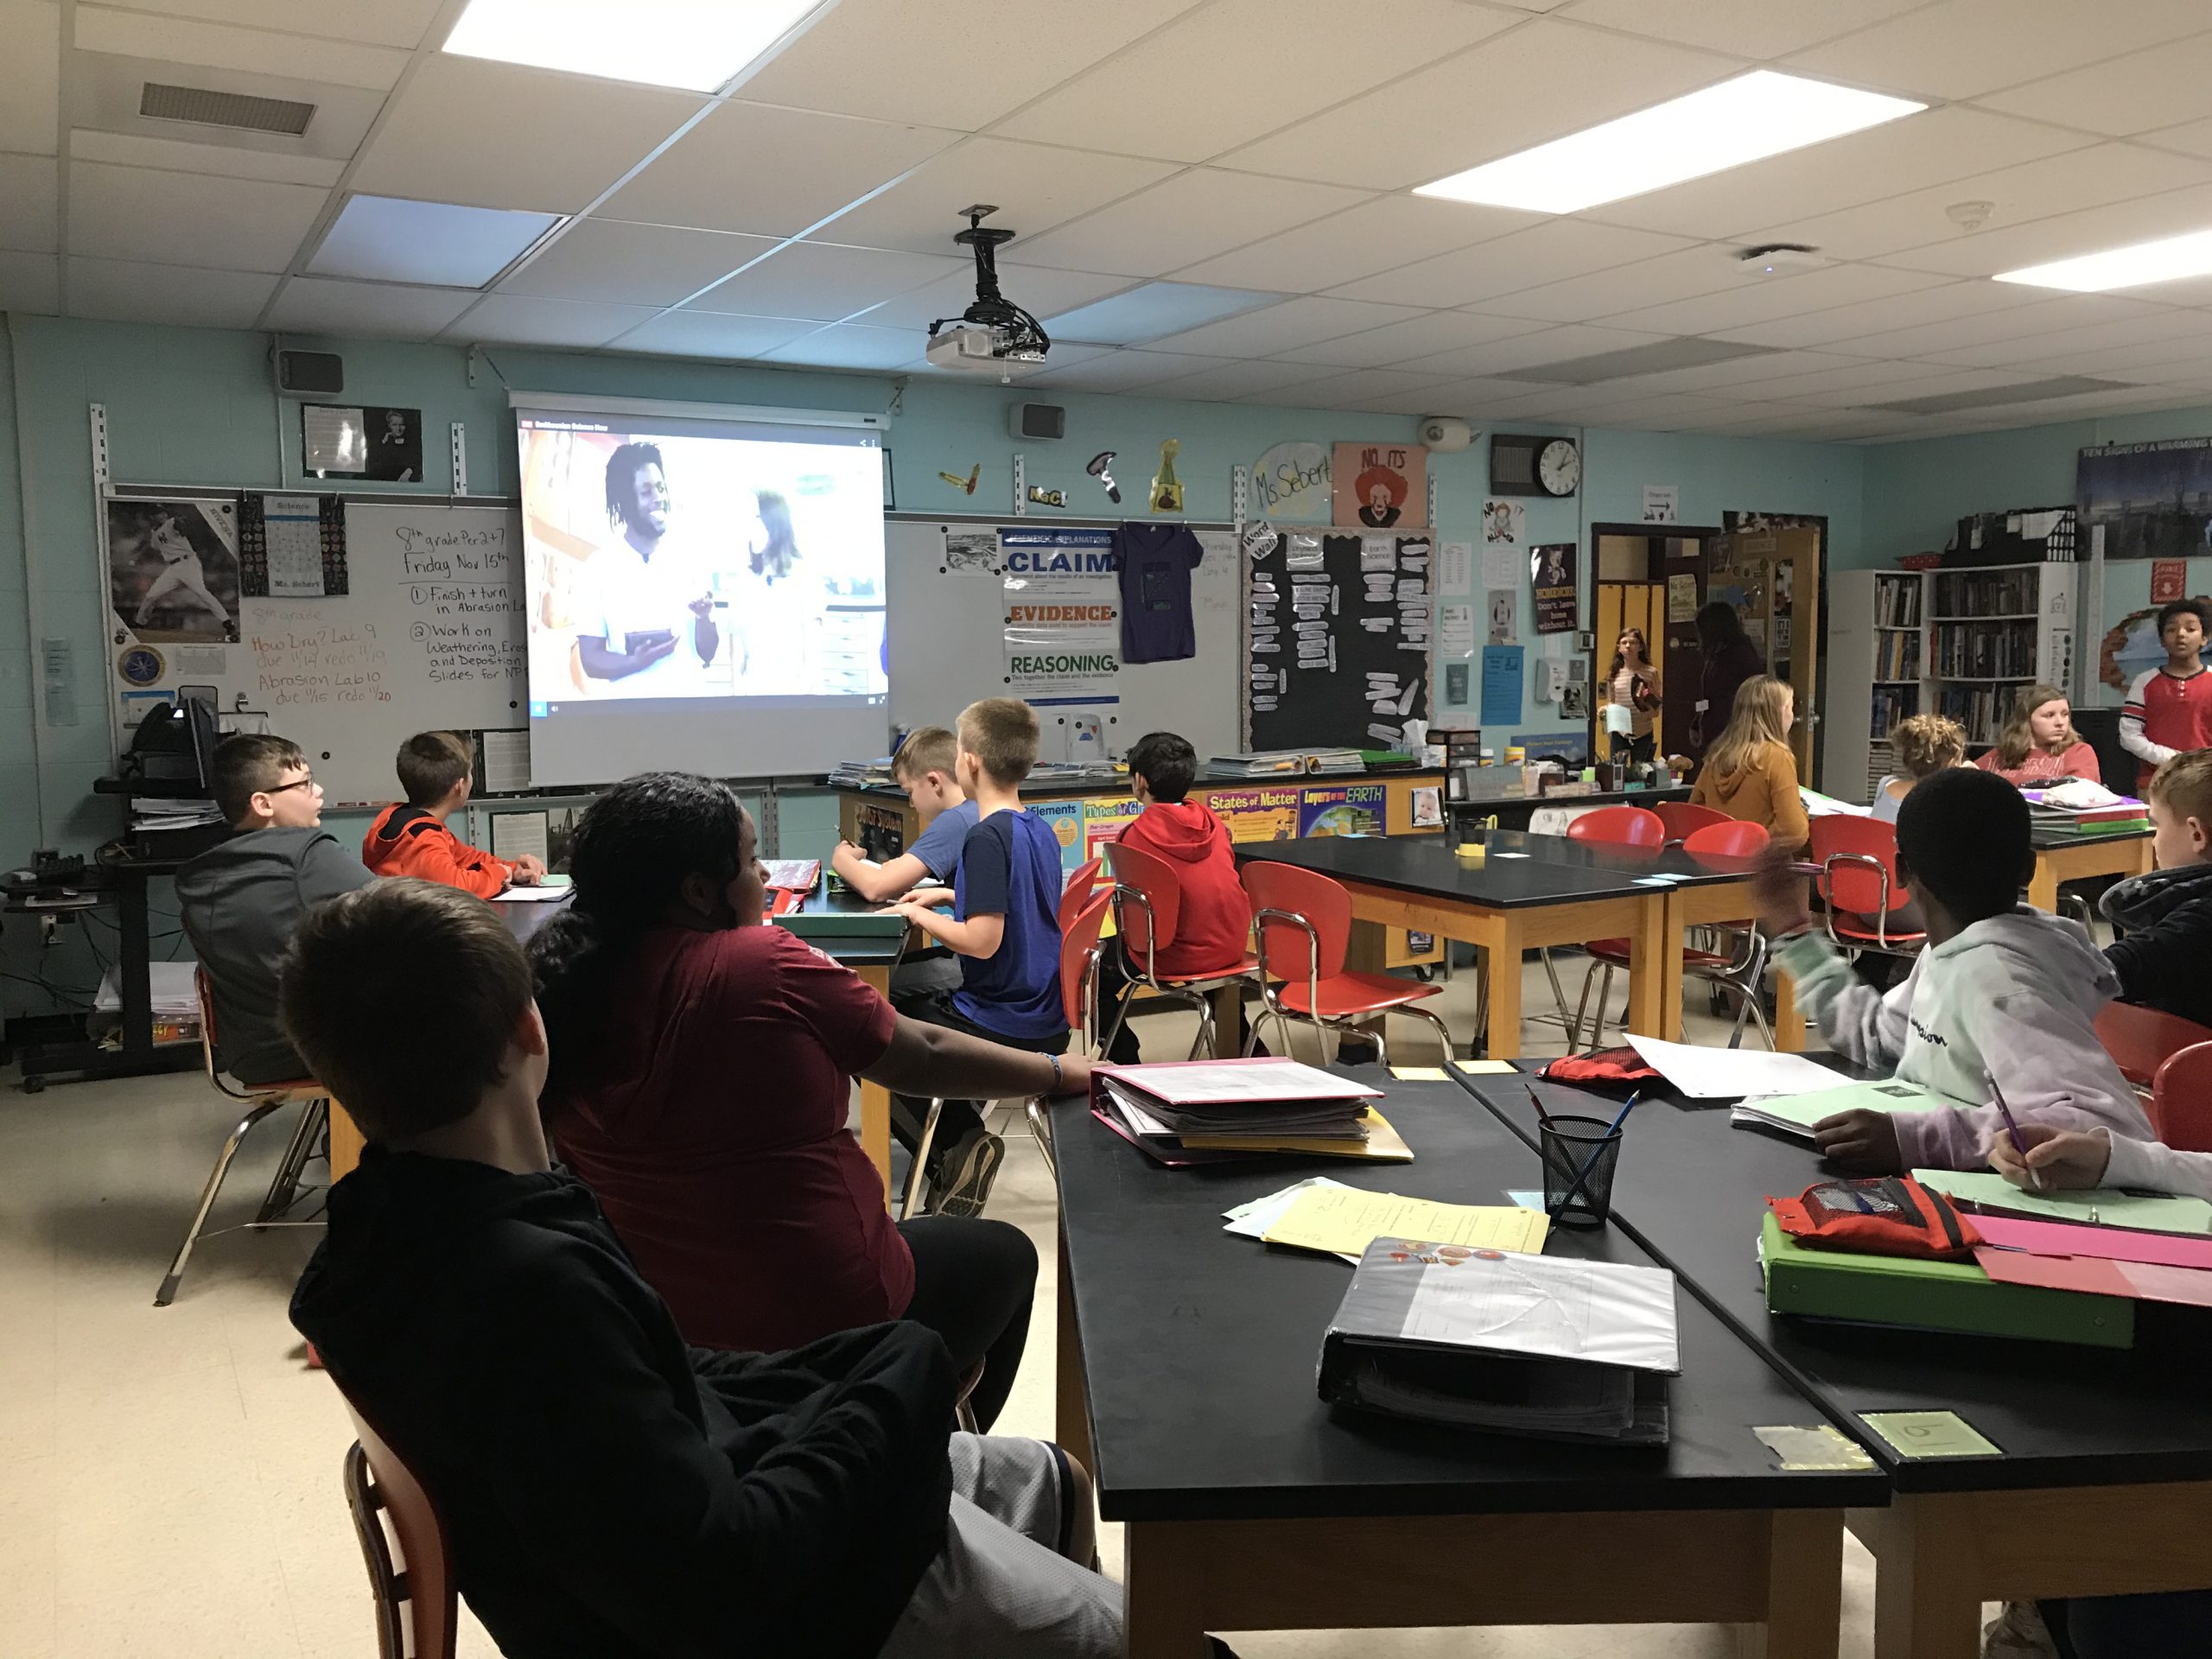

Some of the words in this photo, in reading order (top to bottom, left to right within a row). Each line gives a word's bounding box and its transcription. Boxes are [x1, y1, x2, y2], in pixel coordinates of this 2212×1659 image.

[2148, 443, 2156, 452] A
[1362, 448, 1378, 467] NO
[1276, 455, 1333, 498] Sebert
[1484, 502, 1494, 518] NO
[1243, 521, 1269, 546] Word
[425, 531, 459, 553] grade
[1255, 537, 1276, 557] Wall
[404, 551, 451, 579] Friday
[456, 554, 479, 569] Nov
[1007, 552, 1112, 572] CLAIM
[430, 587, 466, 601] Finish
[480, 587, 507, 600] turn
[435, 604, 451, 614] in
[458, 603, 509, 613] Abrasion
[512, 599, 526, 612] La
[1010, 606, 1112, 621] EVIDENCE
[1537, 601, 1557, 610] Don't
[280, 610, 323, 628] grade
[1538, 620, 1566, 631] without
[432, 622, 470, 636] Work
[474, 627, 492, 637] on
[251, 636, 285, 652] How
[256, 652, 283, 669] due
[429, 656, 455, 667] and
[458, 655, 521, 667] Deposition
[1011, 655, 1114, 674] REASONING
[259, 674, 330, 691] Abrasion
[334, 673, 364, 686] Lab
[429, 670, 474, 683] Slides
[481, 668, 499, 679] for
[276, 689, 301, 705] due
[337, 689, 365, 702] redo
[1211, 795, 1248, 810] States
[1249, 796, 1259, 806] of
[1260, 791, 1296, 806] Matter
[1305, 790, 1330, 805] Layers
[1345, 787, 1383, 803] EARTH
[1086, 804, 1116, 818] Types
